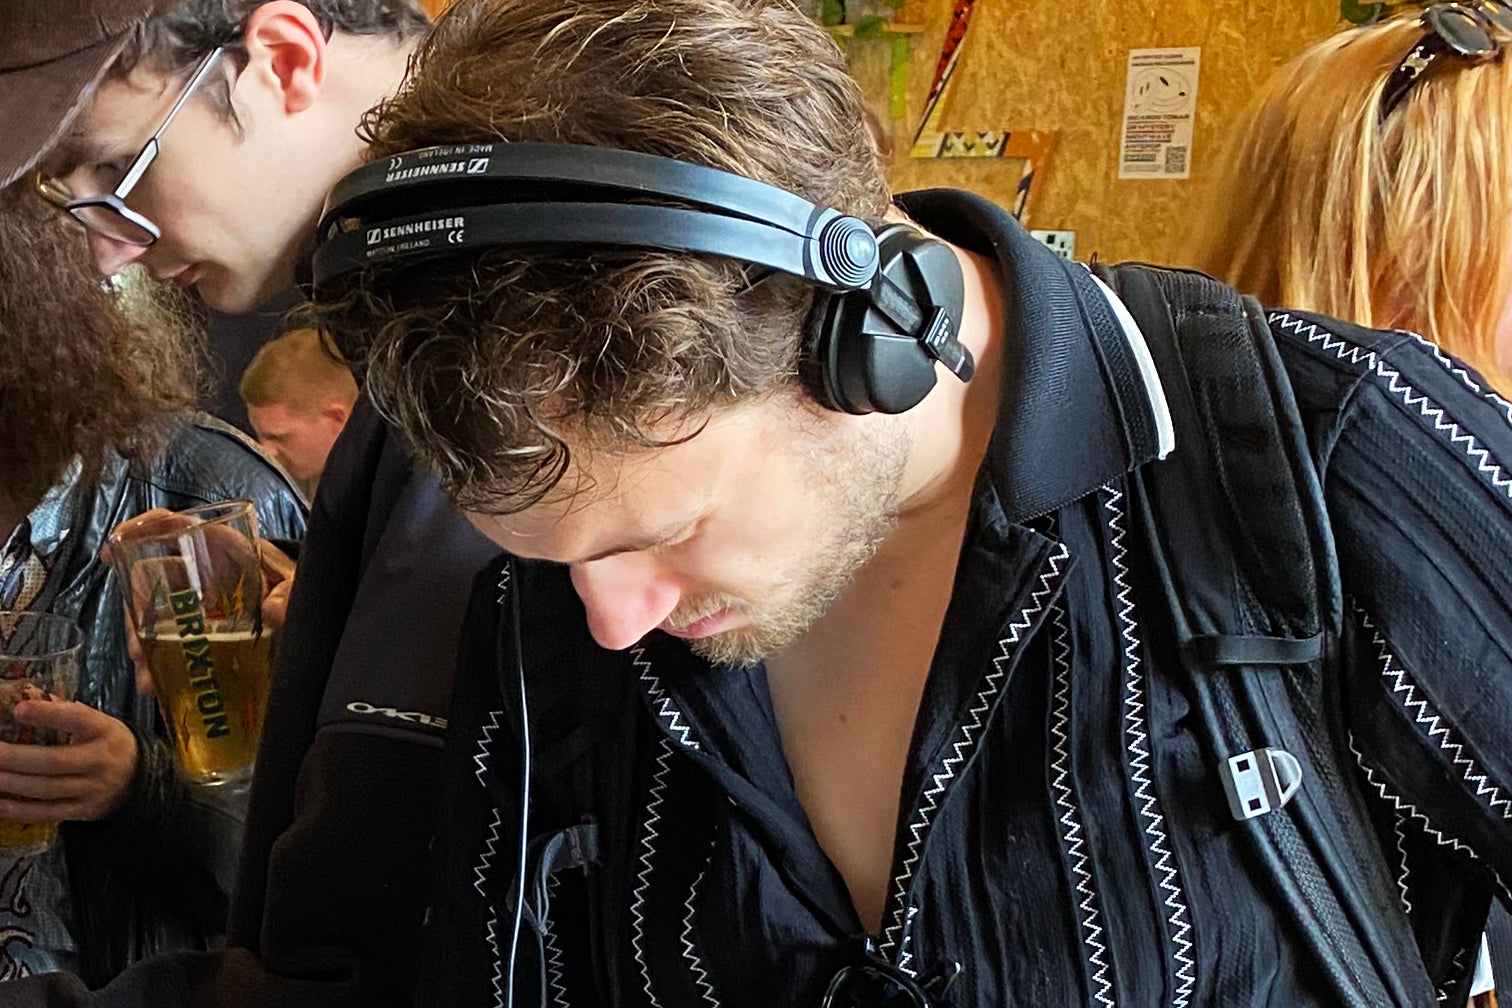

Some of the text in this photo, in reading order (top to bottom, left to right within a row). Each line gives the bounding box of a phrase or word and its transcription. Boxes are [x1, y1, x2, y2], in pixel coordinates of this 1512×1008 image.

[386, 162, 466, 182] SENNHEISER
[383, 217, 464, 239] SENNHEISER
[168, 588, 230, 739] BRIXTON
